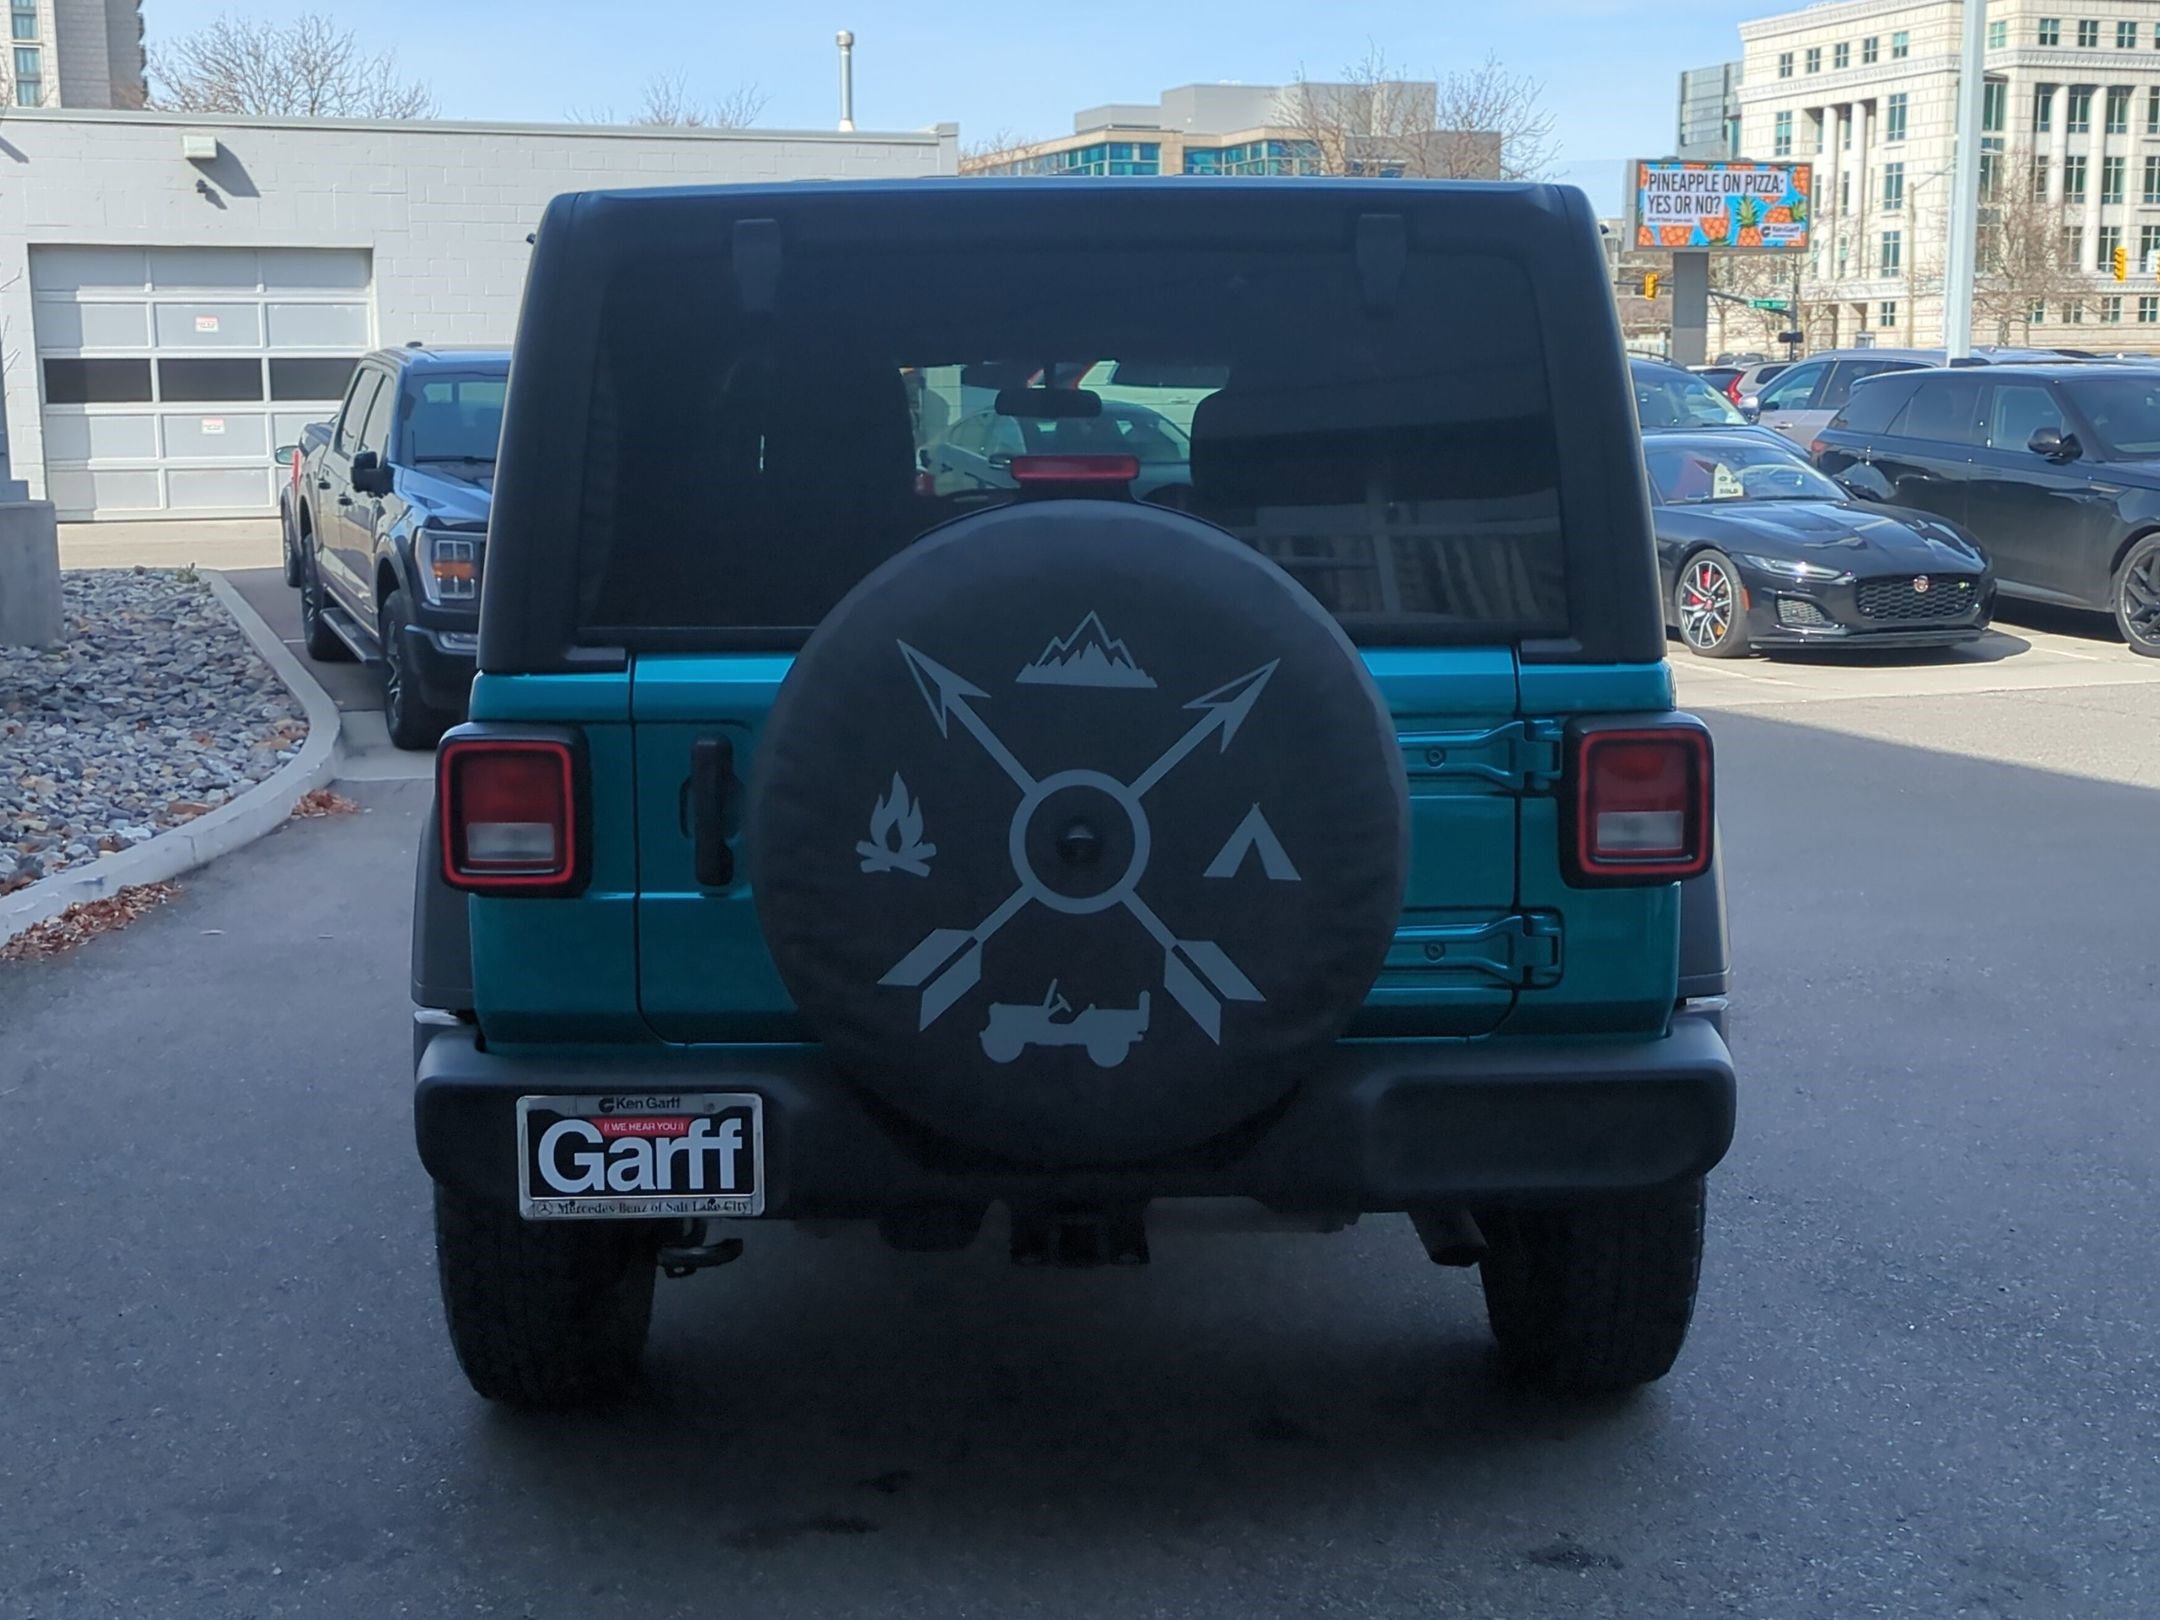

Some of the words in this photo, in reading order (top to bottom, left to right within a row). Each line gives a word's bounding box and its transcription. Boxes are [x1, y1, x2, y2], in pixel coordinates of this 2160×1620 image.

[1648, 173, 1718, 193] PINEAPPLE
[1723, 174, 1741, 193] ON
[1745, 174, 1784, 194] PIZZA:
[1648, 195, 1671, 214] YES
[1674, 195, 1691, 214] OR
[1695, 195, 1721, 215] NO?
[616, 1097, 643, 1110] Ken
[646, 1096, 681, 1110] Garff
[611, 1122, 628, 1131] WE
[629, 1122, 656, 1131] HEAR
[657, 1122, 677, 1131] YOU
[538, 1118, 743, 1193] Garff
[650, 1200, 662, 1213] of
[666, 1199, 689, 1213] Salt
[692, 1199, 720, 1212] Lake
[725, 1198, 749, 1214] City
